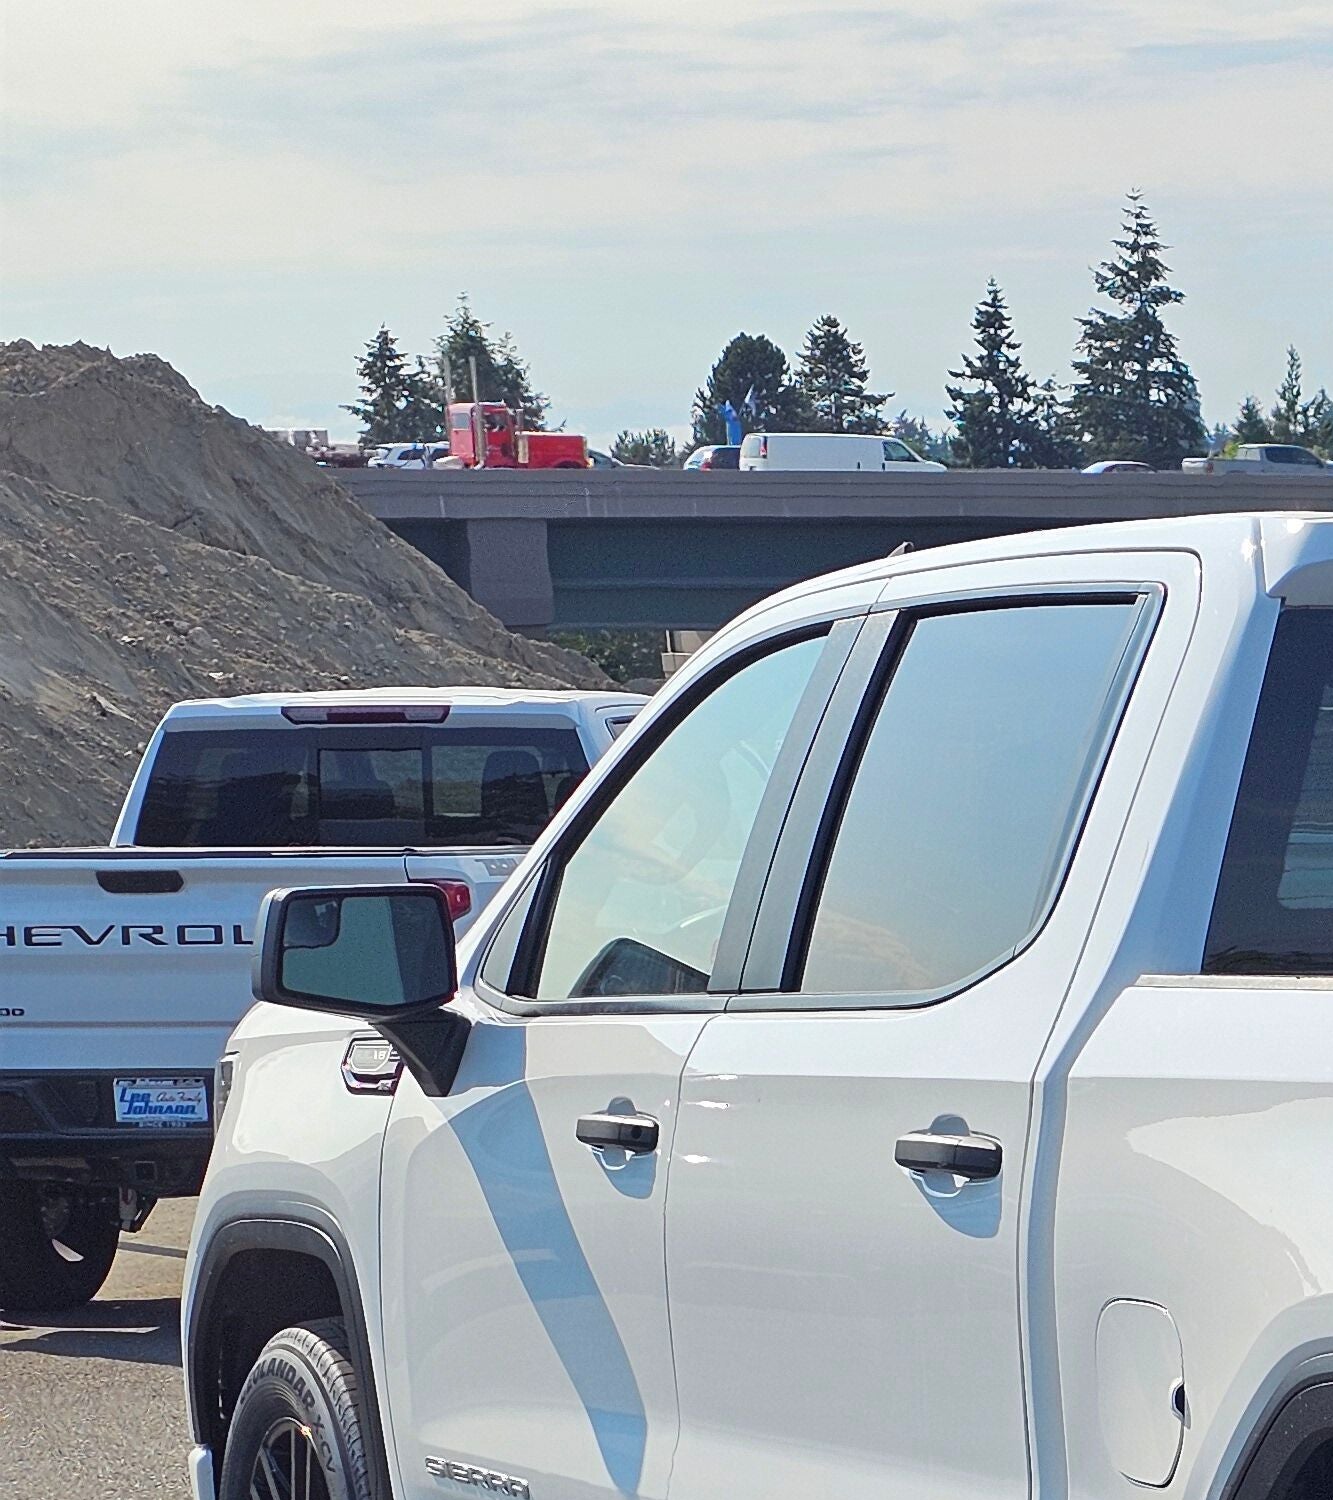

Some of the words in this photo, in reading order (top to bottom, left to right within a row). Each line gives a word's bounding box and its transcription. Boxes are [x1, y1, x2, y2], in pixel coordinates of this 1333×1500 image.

[120, 1087, 151, 1103] Lee
[122, 1102, 197, 1115] Johnson
[424, 1455, 531, 1500] SIERRA
